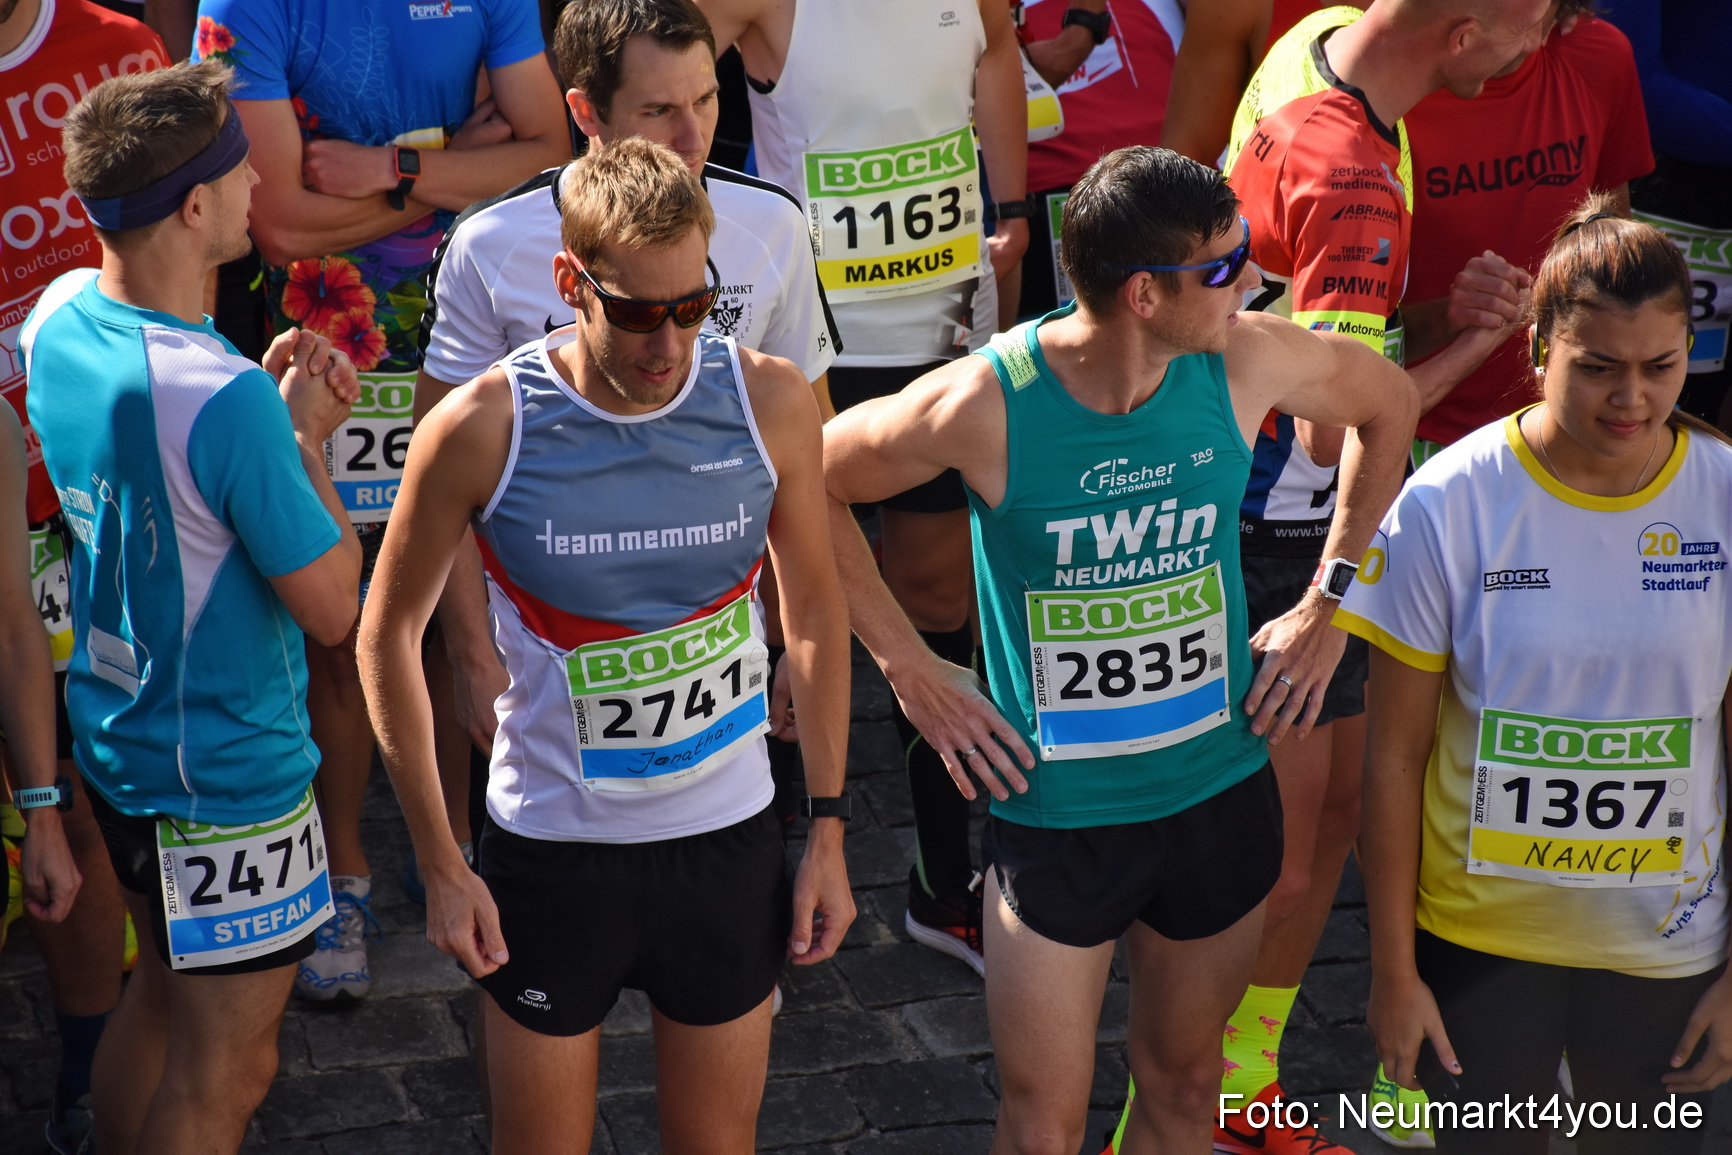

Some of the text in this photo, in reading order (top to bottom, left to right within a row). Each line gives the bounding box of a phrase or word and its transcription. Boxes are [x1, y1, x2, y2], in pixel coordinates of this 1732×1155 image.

[821, 137, 966, 190] BOCK
[1331, 166, 1384, 179] zerbock
[833, 186, 961, 249] 1163
[14, 239, 91, 279] outdoor
[845, 248, 954, 283] MARKUS
[1327, 254, 1366, 262] 100 YEARS
[1341, 246, 1375, 255] THE NEXT
[1322, 276, 1375, 296] BMW
[716, 309, 736, 327] ASV
[1190, 447, 1213, 462] TAO
[1099, 462, 1176, 489] Fischer
[1107, 477, 1172, 496] AUTOMOBILE
[535, 502, 753, 555] team memmert
[1643, 532, 1716, 556] 20 JAHRE
[1054, 543, 1211, 586] NEUMARKT
[1485, 569, 1549, 587] BOCK
[1642, 559, 1727, 573] Neumarkter
[1642, 576, 1711, 591] Stadtlauf
[1045, 578, 1207, 633] BOCK
[583, 610, 740, 686] BOCK
[1057, 629, 1208, 700] 2835
[599, 658, 742, 738] 2741
[627, 721, 734, 774] Jonathan
[1497, 720, 1674, 762] BOCK
[1502, 777, 1667, 829] 1367
[184, 823, 314, 907] 2471
[1525, 841, 1651, 883] NANCY
[214, 893, 311, 943] STEFAN
[517, 995, 551, 1011] Kalenji
